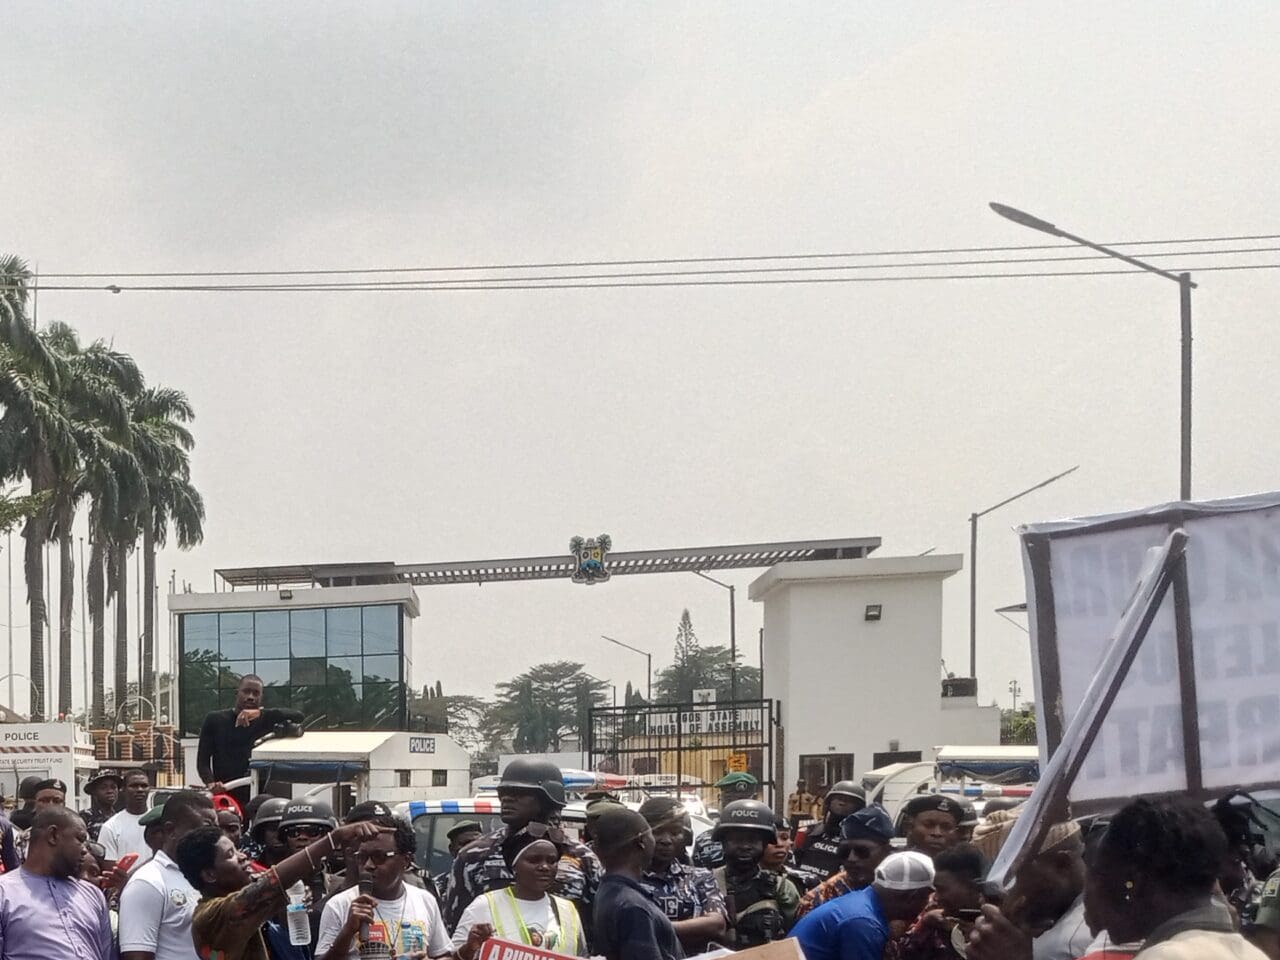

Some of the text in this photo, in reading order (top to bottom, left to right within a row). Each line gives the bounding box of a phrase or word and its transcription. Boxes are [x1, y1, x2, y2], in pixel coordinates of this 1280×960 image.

[709, 710, 740, 722] STATE
[649, 724, 681, 736] HOUS
[689, 722, 702, 733] OF
[4, 732, 40, 741] POLICE
[410, 738, 435, 752] POLICE
[287, 805, 313, 814] POLICE
[731, 809, 760, 818] POLICE
